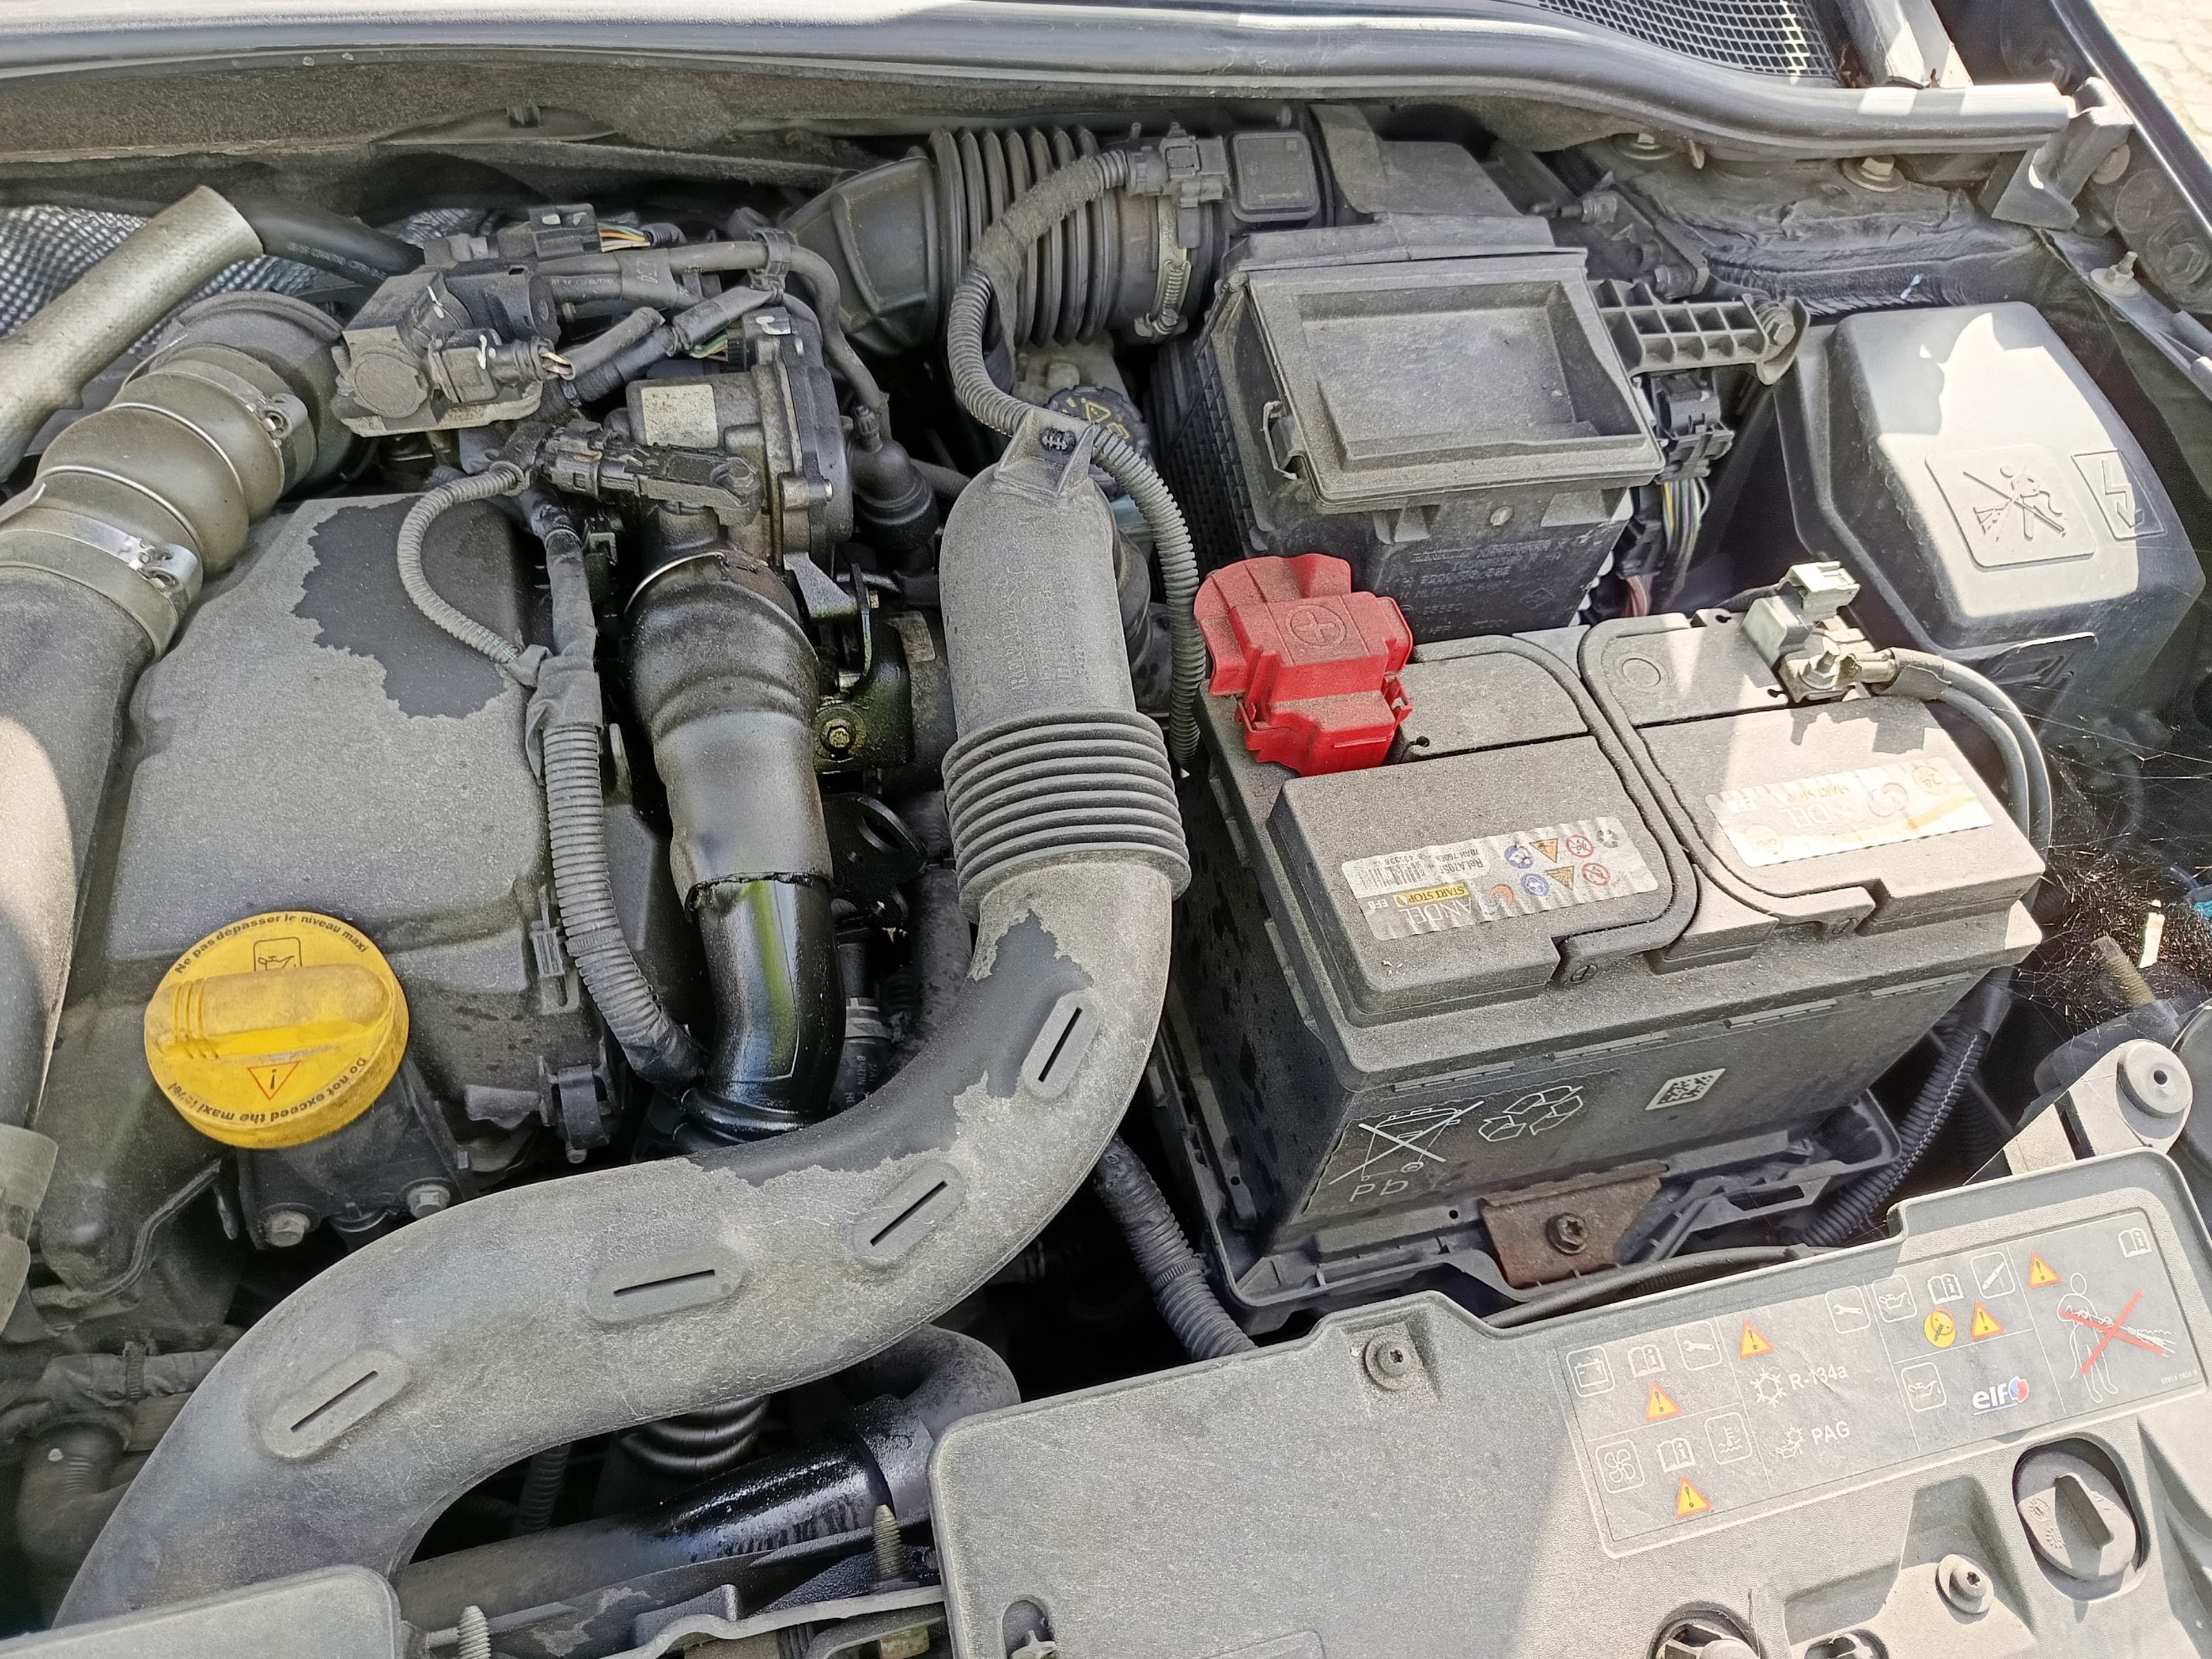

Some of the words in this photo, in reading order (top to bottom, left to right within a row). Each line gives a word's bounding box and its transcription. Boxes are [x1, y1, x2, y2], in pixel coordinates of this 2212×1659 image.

[1408, 892, 1434, 903] STOP
[1435, 885, 1465, 899] START
[1367, 898, 1389, 910] EFB
[1399, 897, 1472, 924] ANDEL
[175, 957, 192, 974] Ne
[193, 938, 216, 959] pas
[216, 915, 282, 941] dépasser
[285, 913, 297, 922] le
[301, 915, 342, 934] niveau
[343, 929, 369, 953] maxi
[350, 1057, 368, 1074] Do
[327, 1074, 350, 1095] not
[199, 1101, 236, 1121] maxi
[270, 1093, 325, 1120] exceed
[239, 1112, 266, 1124] the
[1789, 1363, 1849, 1391] R-134a
[1972, 1382, 2008, 1410] elf
[1810, 1421, 1850, 1445] PAG
